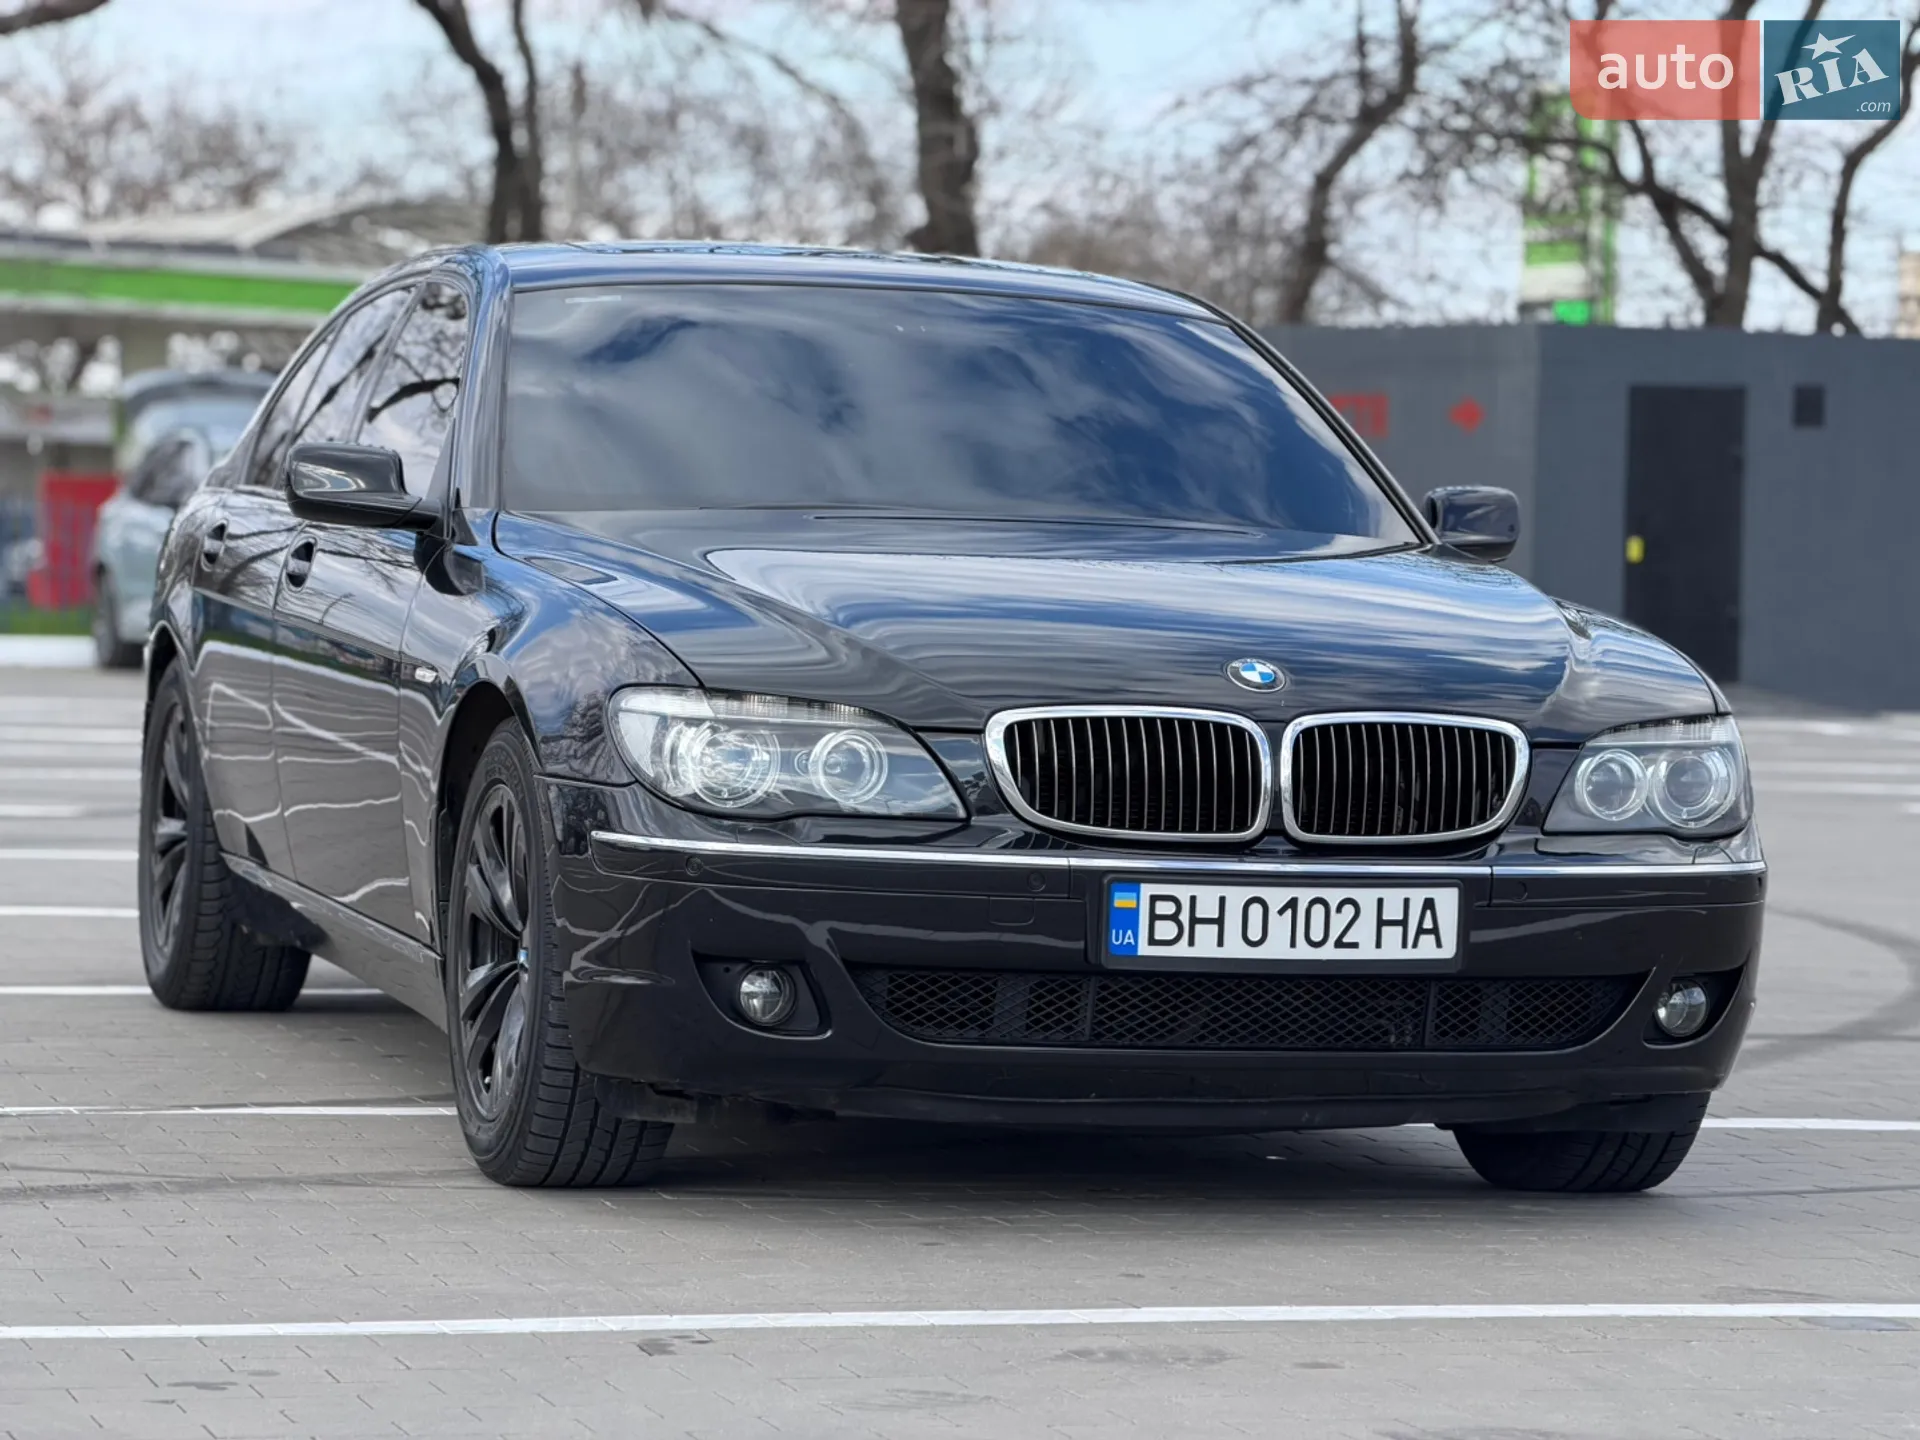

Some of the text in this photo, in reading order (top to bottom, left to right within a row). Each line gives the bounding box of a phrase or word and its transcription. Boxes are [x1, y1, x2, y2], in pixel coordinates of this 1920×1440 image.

[1111, 928, 1135, 946] UA
[1146, 893, 1443, 950] BH 0102 HA
